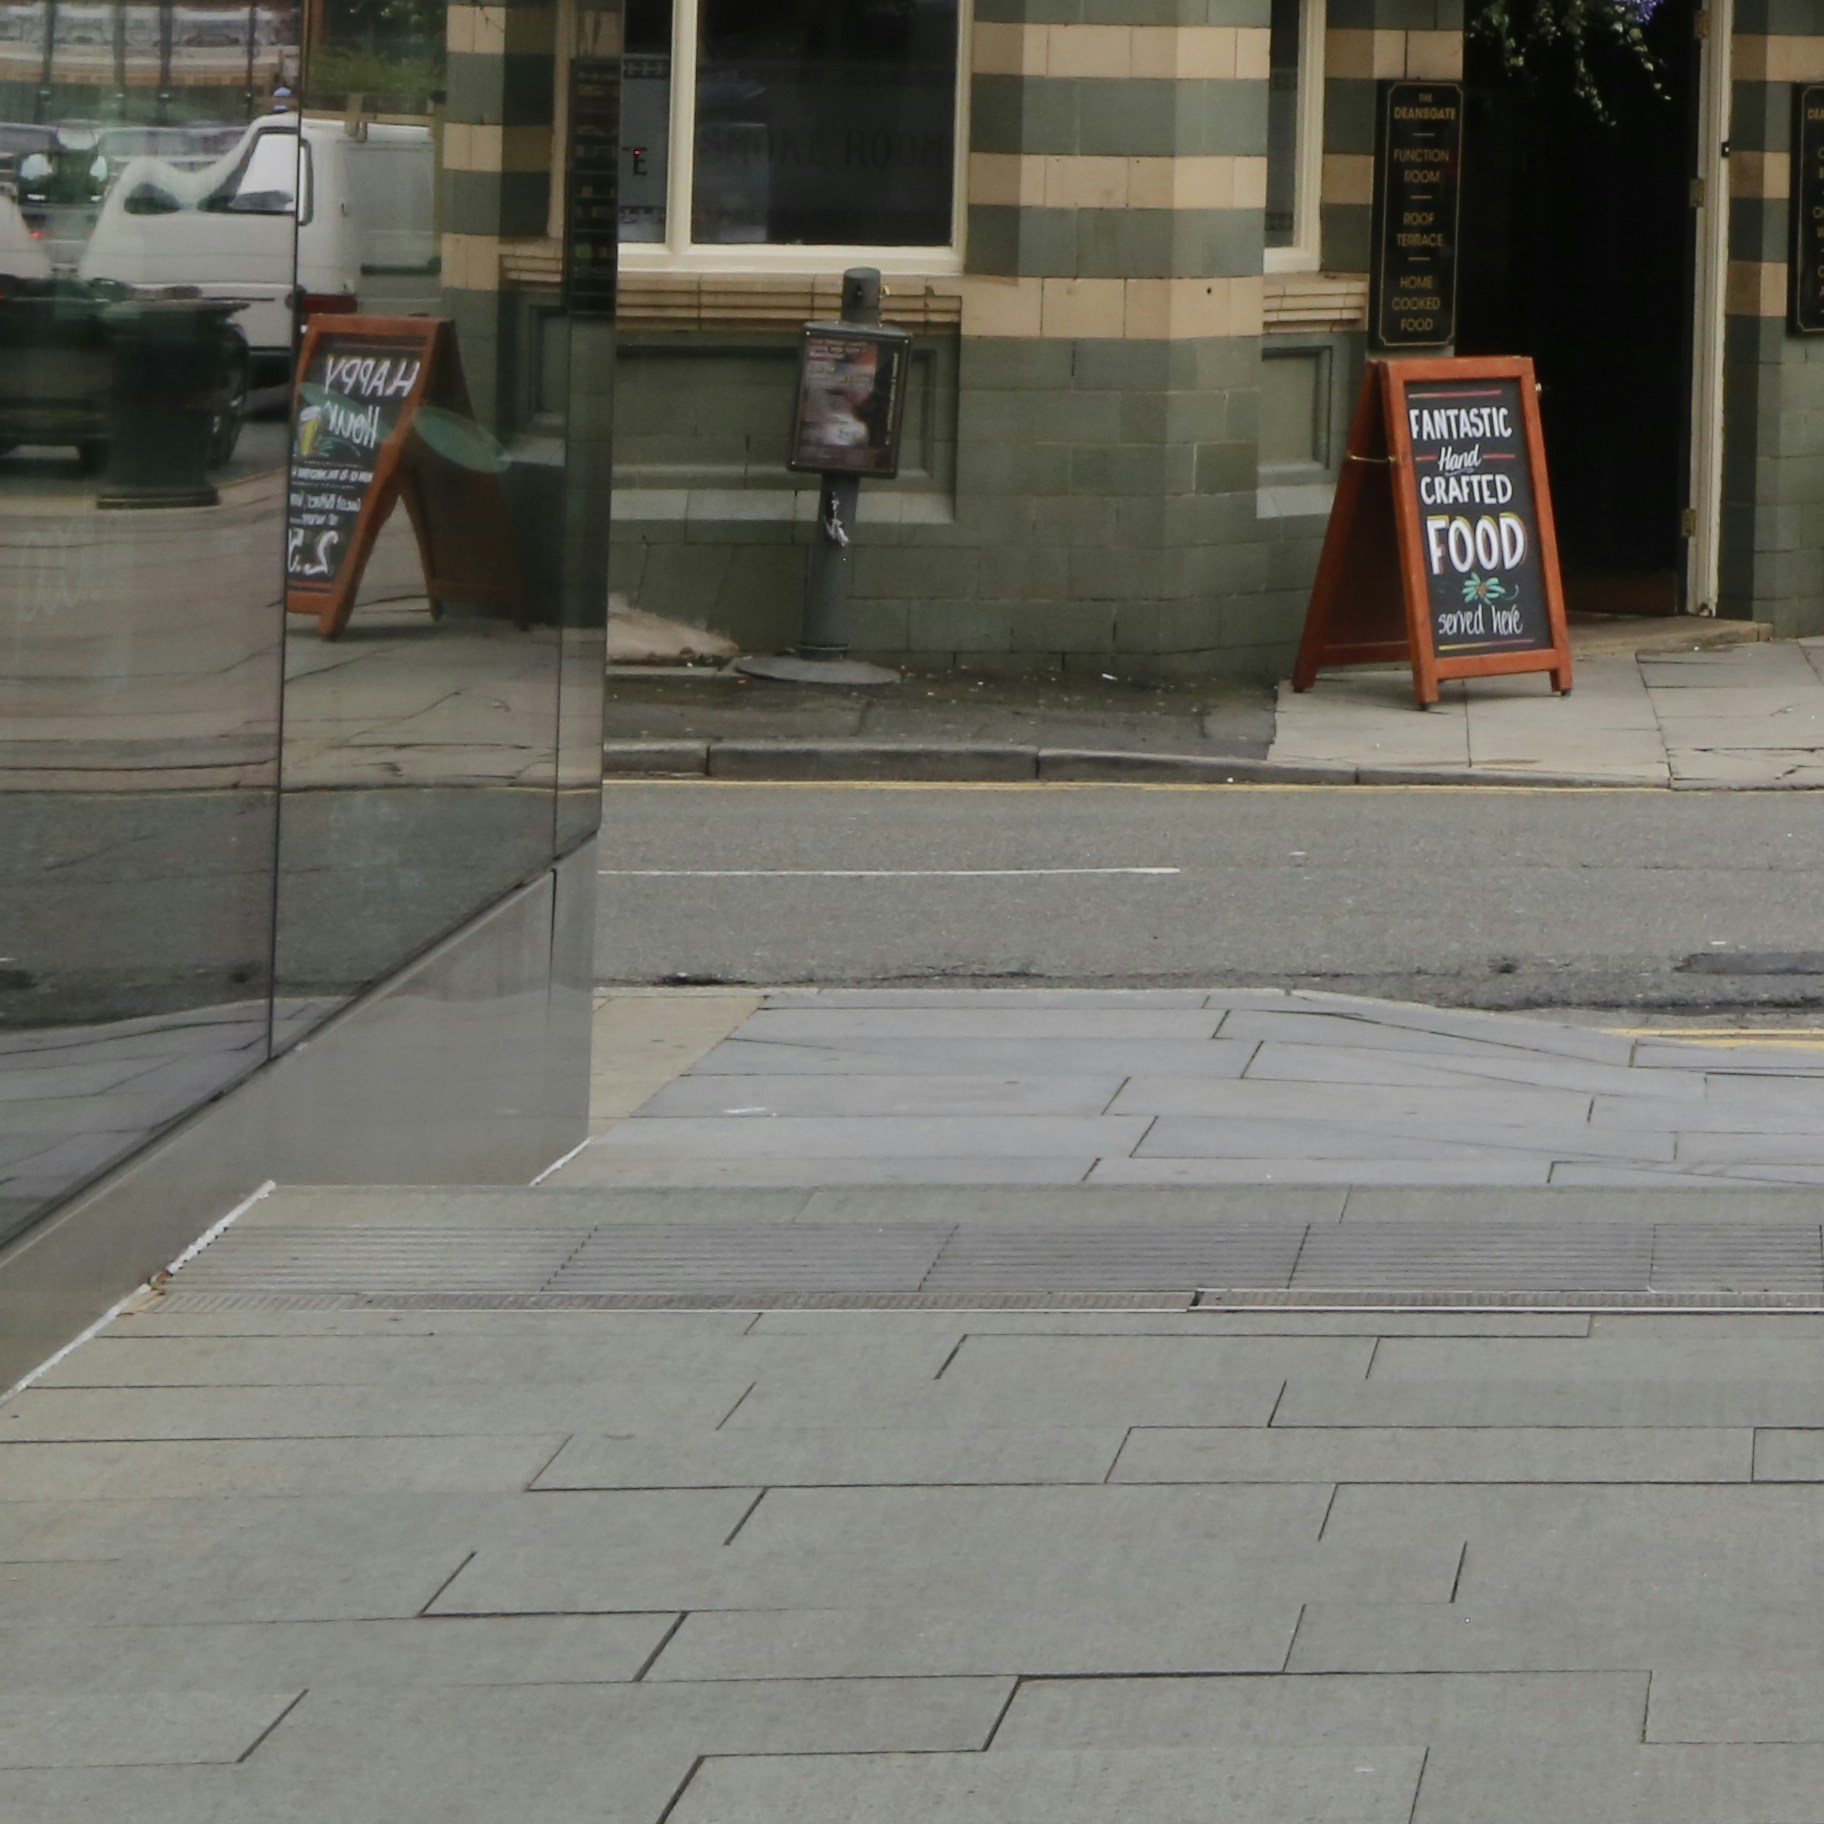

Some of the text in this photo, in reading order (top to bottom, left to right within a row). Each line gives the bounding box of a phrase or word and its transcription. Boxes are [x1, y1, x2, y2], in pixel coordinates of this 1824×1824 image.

[1393, 105, 1456, 120] DEANSGATE
[1393, 147, 1450, 162] FUNCTION
[1403, 169, 1441, 183] ROOM
[1403, 212, 1435, 225] ROOF
[1396, 232, 1444, 247] TERRACE
[1400, 275, 1433, 289] HOME
[1391, 296, 1441, 310] COOKED
[1401, 317, 1434, 331] FOOD
[1409, 406, 1513, 441] FANTASTIC
[1438, 444, 1482, 473] Hand
[1420, 473, 1513, 505] CRAFTED
[1425, 512, 1527, 576] FOOD
[1438, 603, 1523, 636] served here
